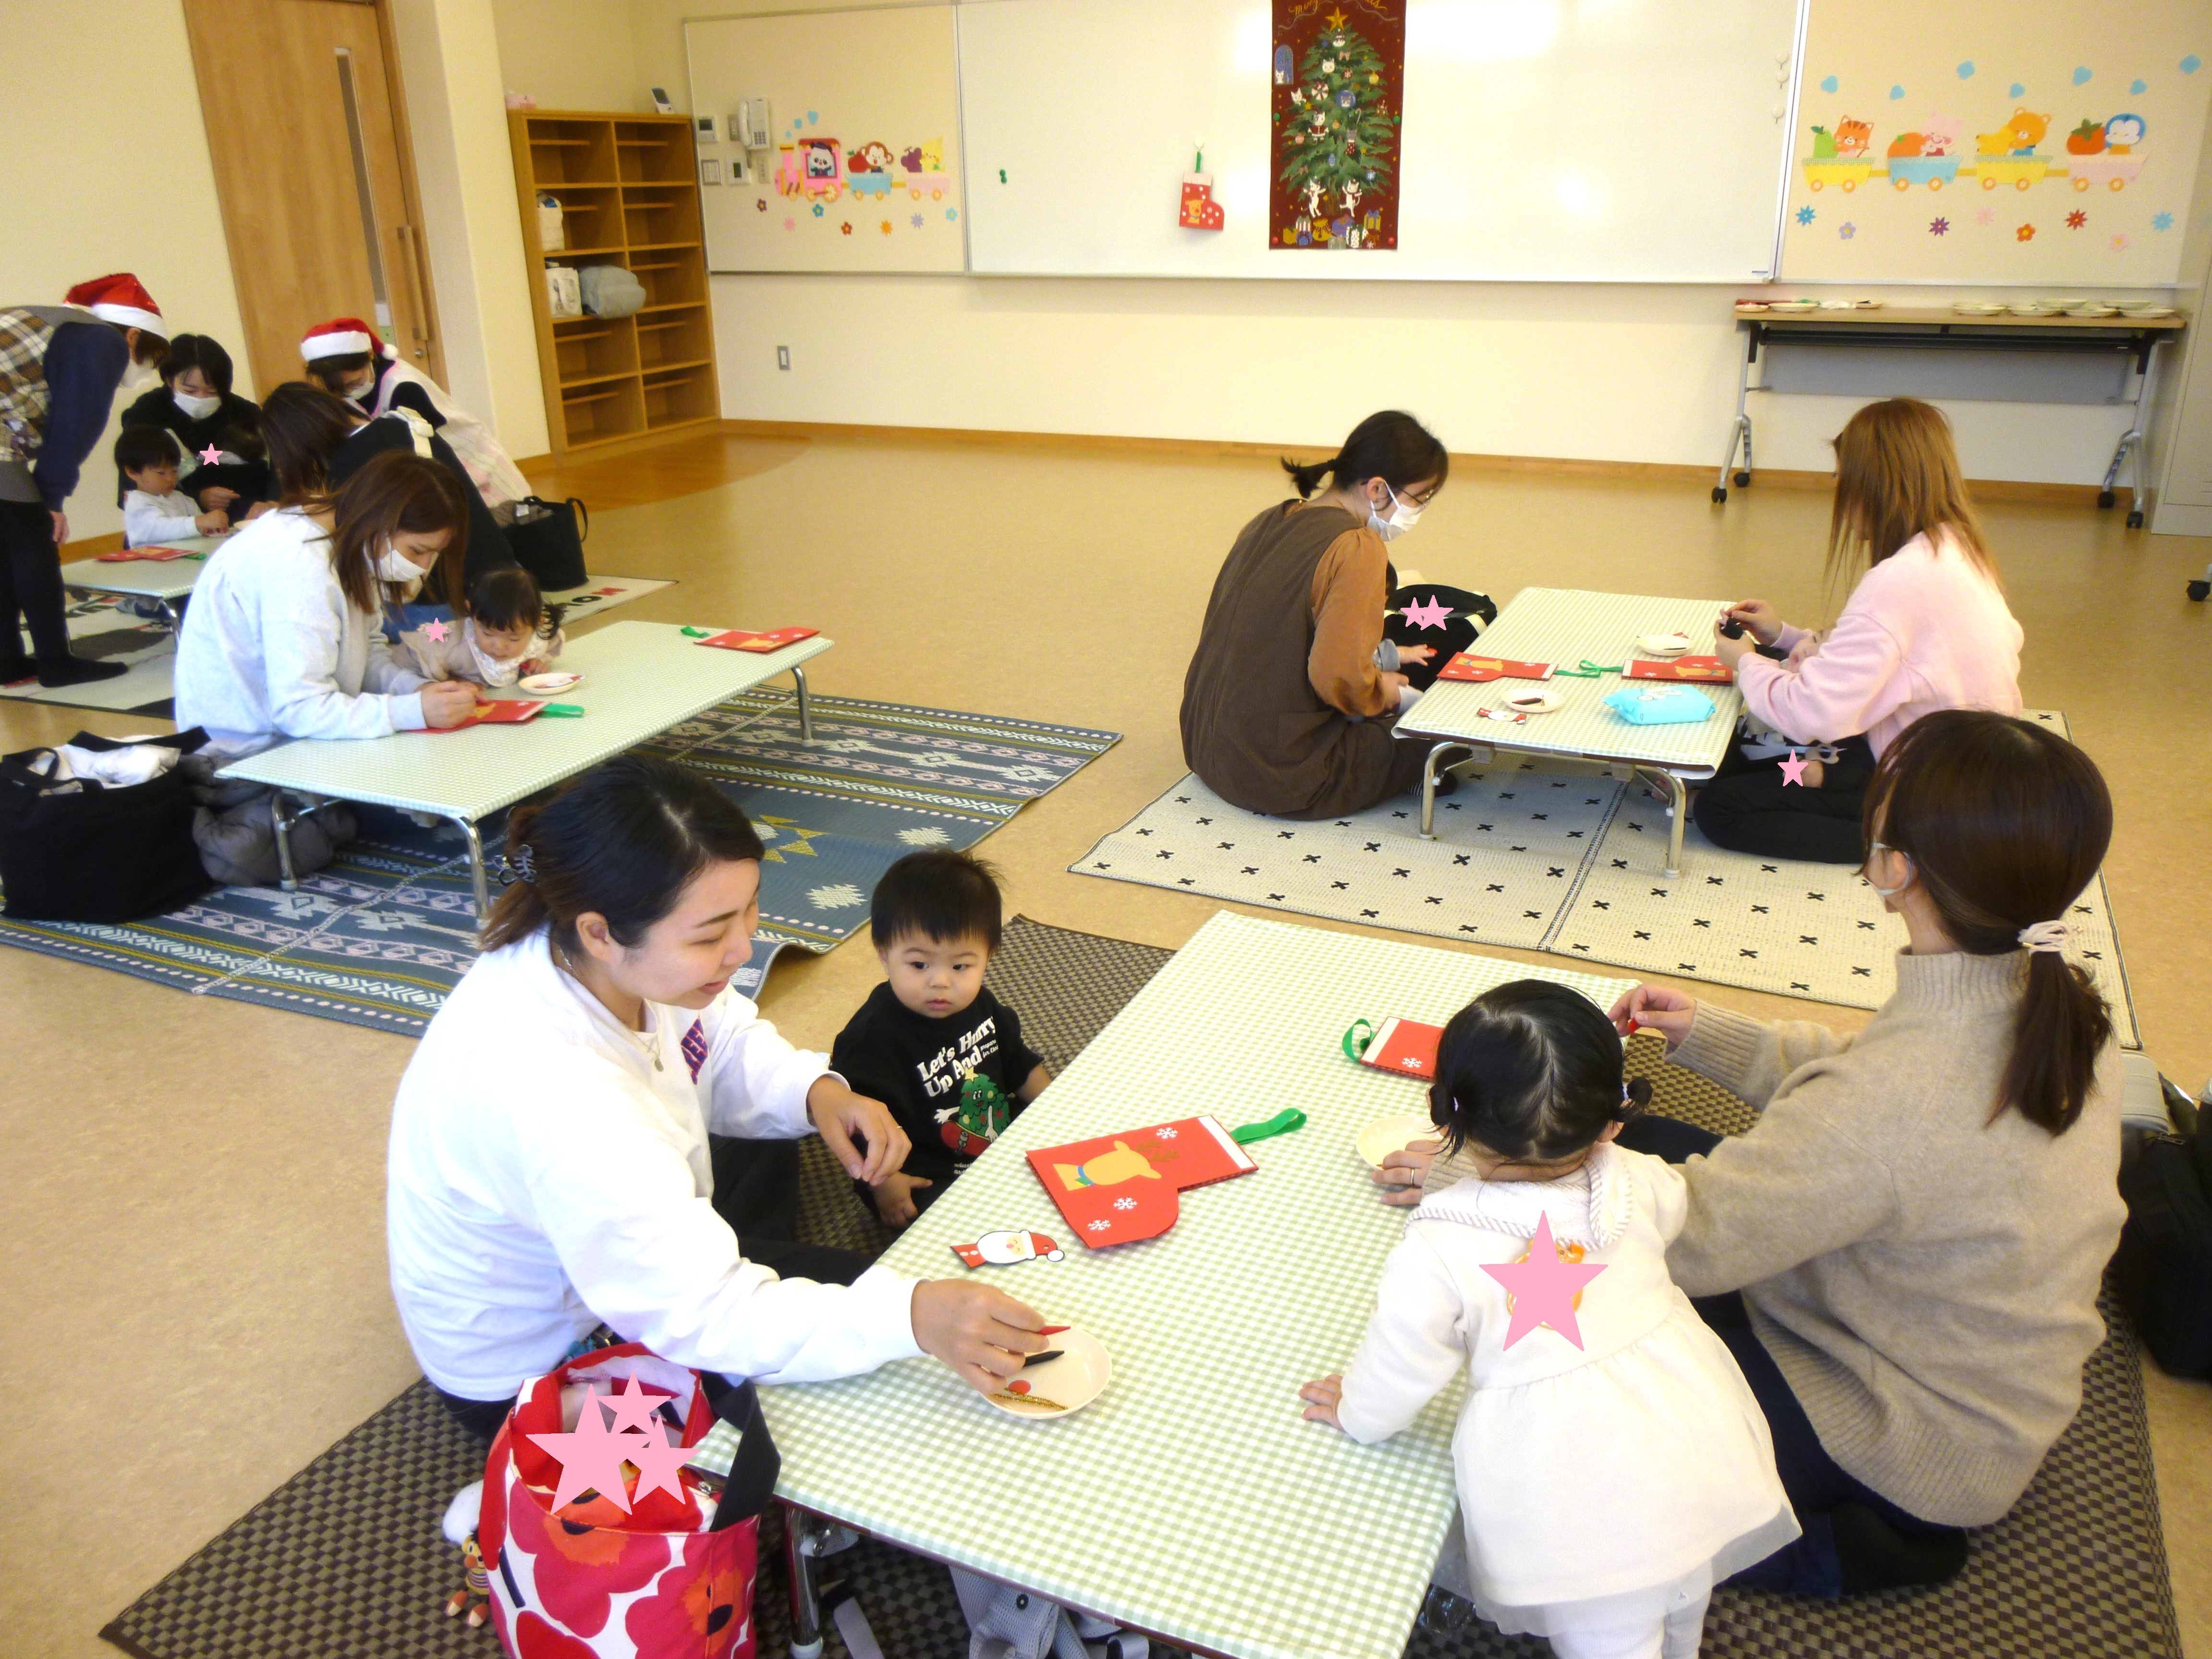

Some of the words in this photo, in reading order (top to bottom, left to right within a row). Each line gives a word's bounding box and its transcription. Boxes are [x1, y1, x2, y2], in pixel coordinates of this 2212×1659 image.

[917, 1046, 955, 1081] Let's
[924, 1074, 953, 1097] Up
[952, 1045, 983, 1080] And
